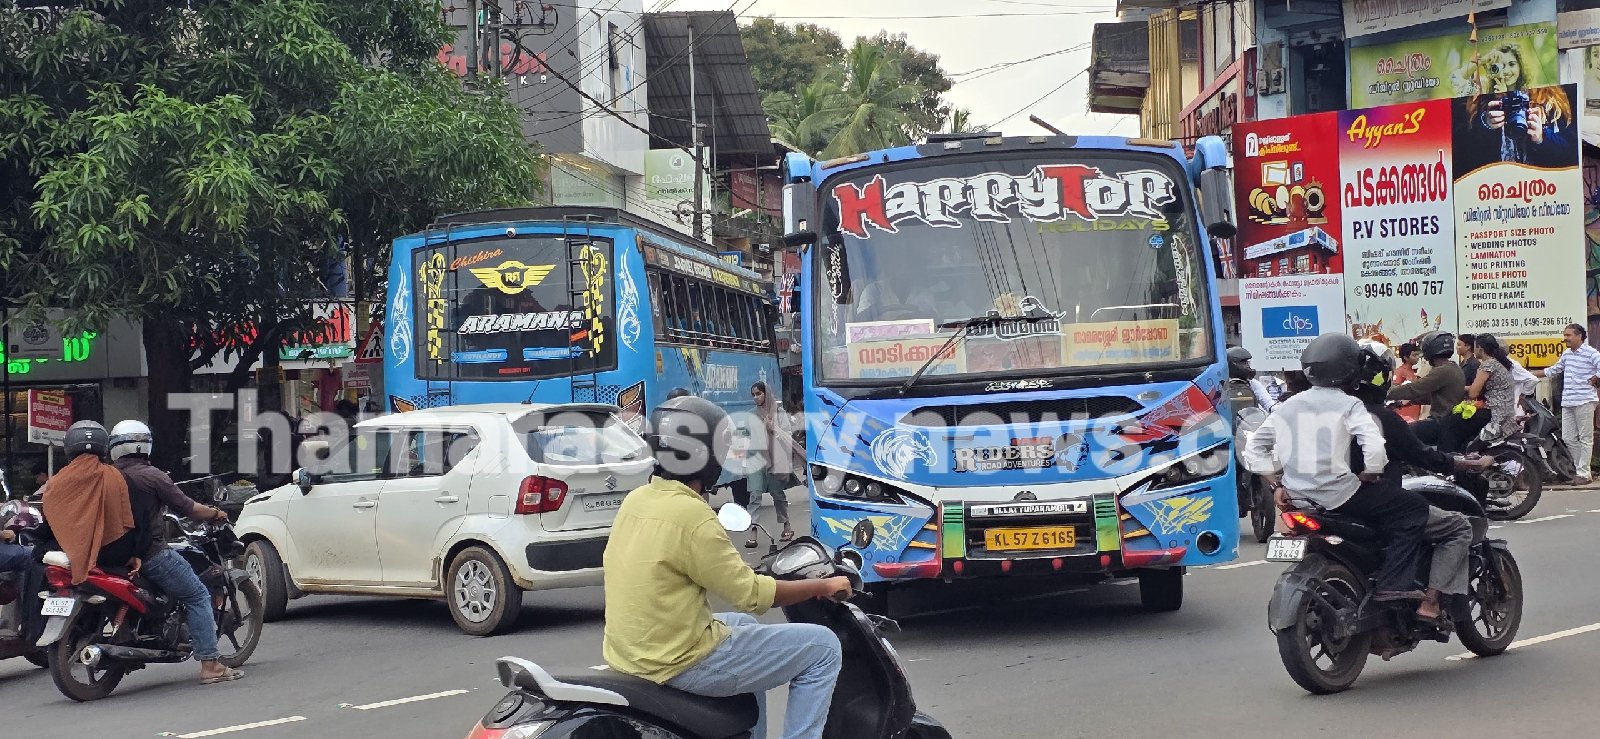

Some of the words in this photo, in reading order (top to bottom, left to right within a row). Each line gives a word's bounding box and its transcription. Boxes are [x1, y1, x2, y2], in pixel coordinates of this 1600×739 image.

[1376, 53, 1432, 79] ചൈത്രം
[1344, 149, 1448, 208] പടക്കങ്ങൾ
[1477, 179, 1557, 203] ചൈത്രം
[1532, 206, 1537, 217] &
[1539, 202, 1570, 217] വീഡിയോ
[1037, 219, 1170, 233] HOLIDAYS
[1353, 220, 1374, 240] P.V
[1380, 215, 1440, 238] STORES
[1470, 230, 1508, 239] PASSPORT
[1510, 228, 1527, 237] SIZE
[1529, 227, 1555, 236] PHOTO
[1471, 240, 1504, 250] WEDDING
[1507, 239, 1537, 248] PHOTOS
[449, 249, 504, 271] Chithira
[1470, 250, 1516, 259] LAMINATION
[1471, 262, 1488, 270] MUG
[1490, 260, 1526, 269] PRINTING
[1472, 272, 1500, 280] MOBILE
[1502, 270, 1527, 279] PHOTO
[1365, 284, 1392, 298] 9946
[1396, 282, 1419, 297] 400
[1422, 281, 1444, 295] 767
[1472, 282, 1499, 291] DIGITAL
[1502, 281, 1528, 289] ALBUM
[1472, 292, 1497, 300] PHOTO
[1499, 291, 1525, 299] FRAME
[1472, 302, 1497, 311] PHOTO
[1500, 301, 1546, 310] LAMINATION
[457, 310, 585, 335] ARAMANA
[1509, 341, 1565, 359] ട്ടോസ്റ്റാറ്റ്
[952, 444, 1055, 472] RIDERS
[981, 461, 1001, 471] ROAD
[1003, 460, 1051, 470] ADVENTURES
[995, 533, 1010, 546] KL
[1013, 533, 1028, 545] 57
[1291, 540, 1302, 548] 57
